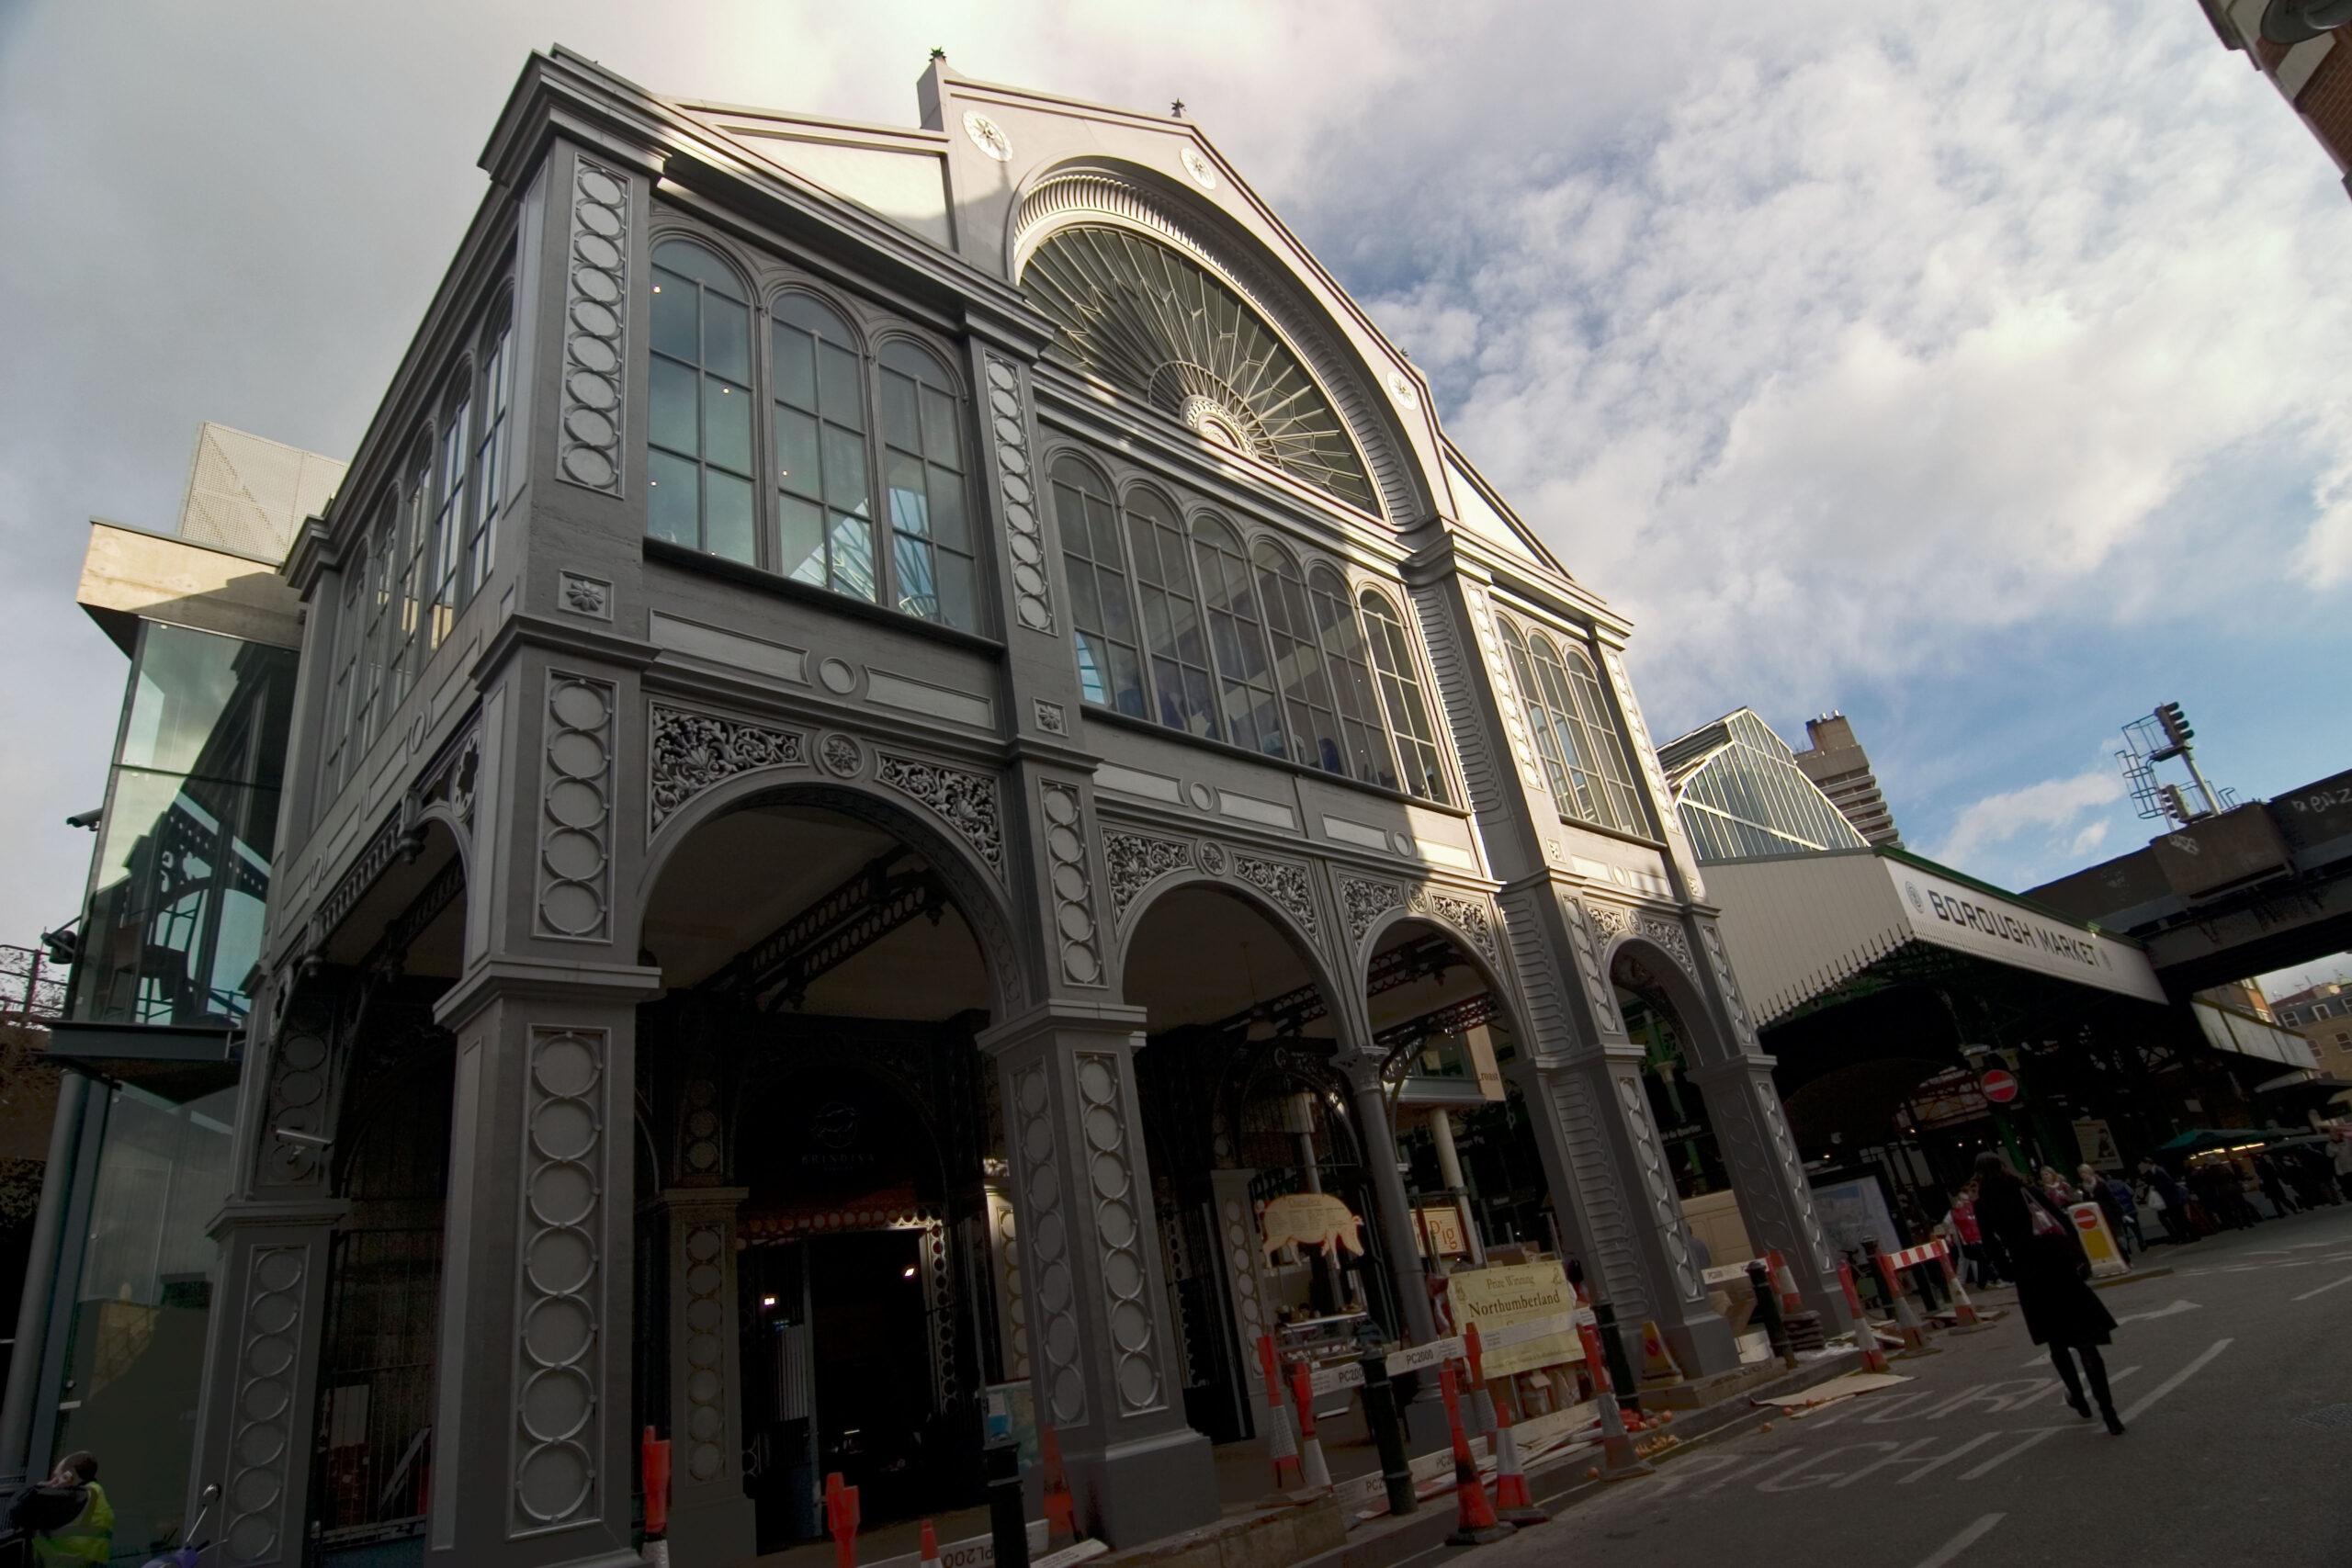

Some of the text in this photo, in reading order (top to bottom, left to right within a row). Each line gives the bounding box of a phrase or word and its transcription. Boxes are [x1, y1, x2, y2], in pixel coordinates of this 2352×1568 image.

[1928, 889, 2100, 967] BOROUGH MARKET
[1468, 1290, 1561, 1317] Northumberland
[1406, 1349, 1433, 1365] PC2000
[1339, 1366, 1364, 1382] PC200
[941, 1545, 994, 1568] PL200
